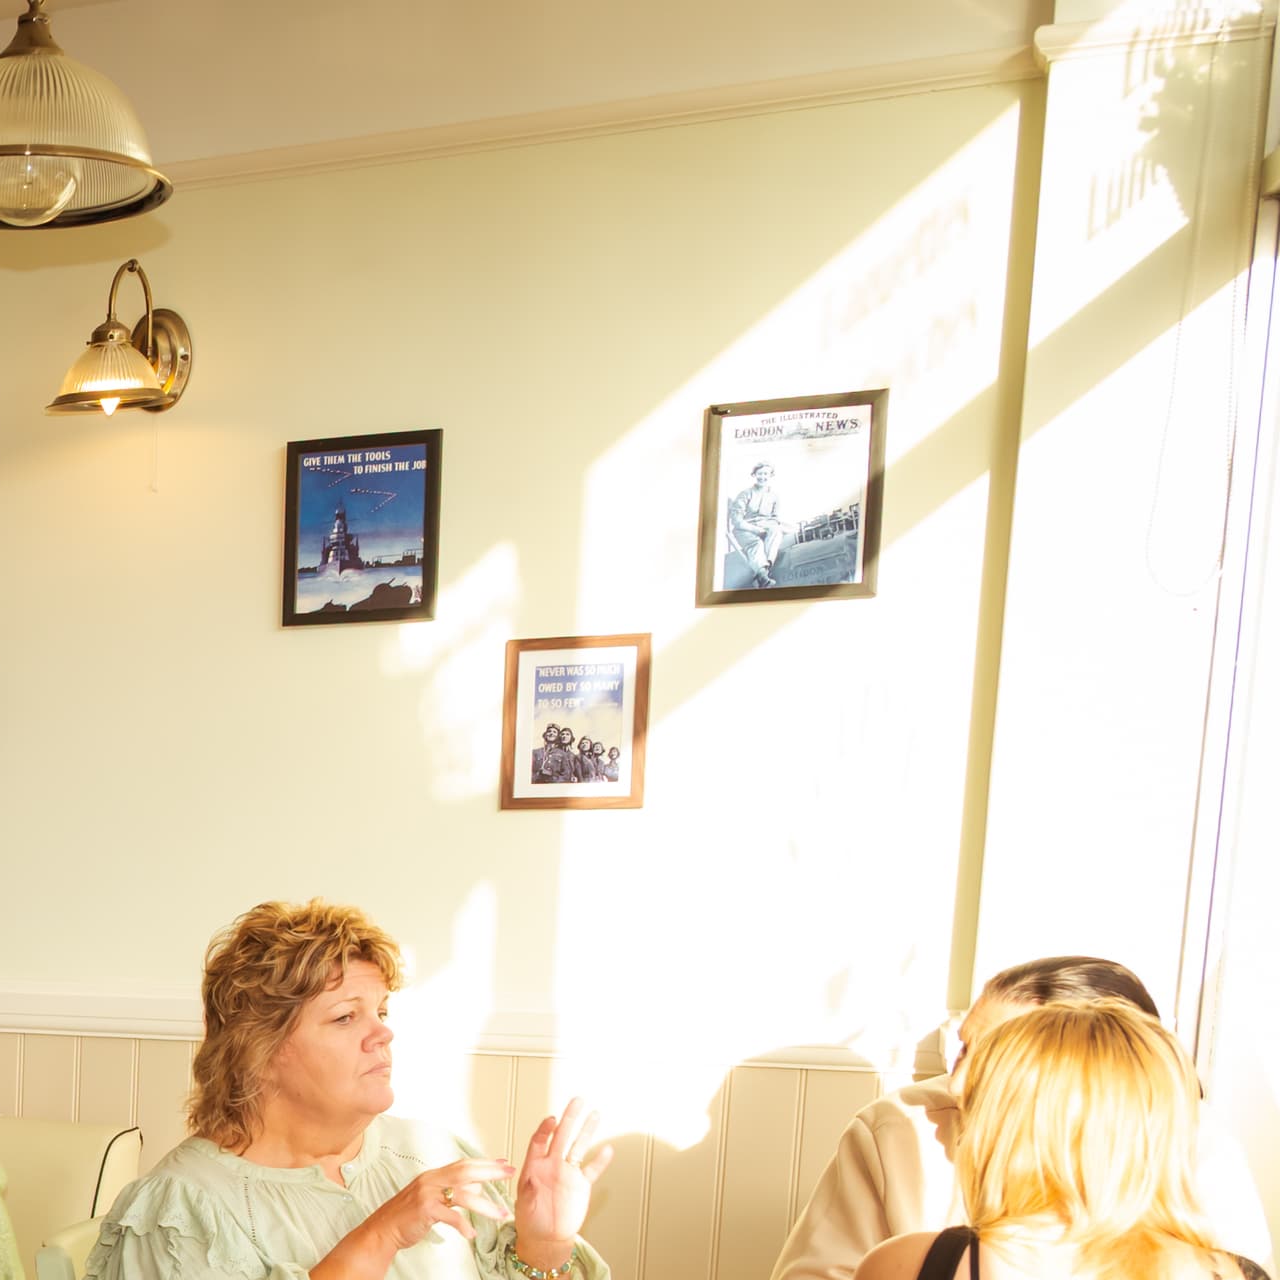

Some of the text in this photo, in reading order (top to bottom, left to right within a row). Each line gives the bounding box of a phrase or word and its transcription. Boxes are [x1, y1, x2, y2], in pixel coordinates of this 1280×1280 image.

[780, 412, 838, 421] ILLUSTRATED
[734, 418, 859, 439] LONDON NEWS
[303, 450, 391, 467] GIVE THEM THE TOOLS
[353, 459, 427, 475] TO FINISH THE JOB
[566, 665, 584, 676] WAS
[585, 665, 596, 675] SO
[538, 680, 620, 693] OWED BY SO MANY
[537, 698, 549, 709] TO
[551, 698, 562, 708] SO
